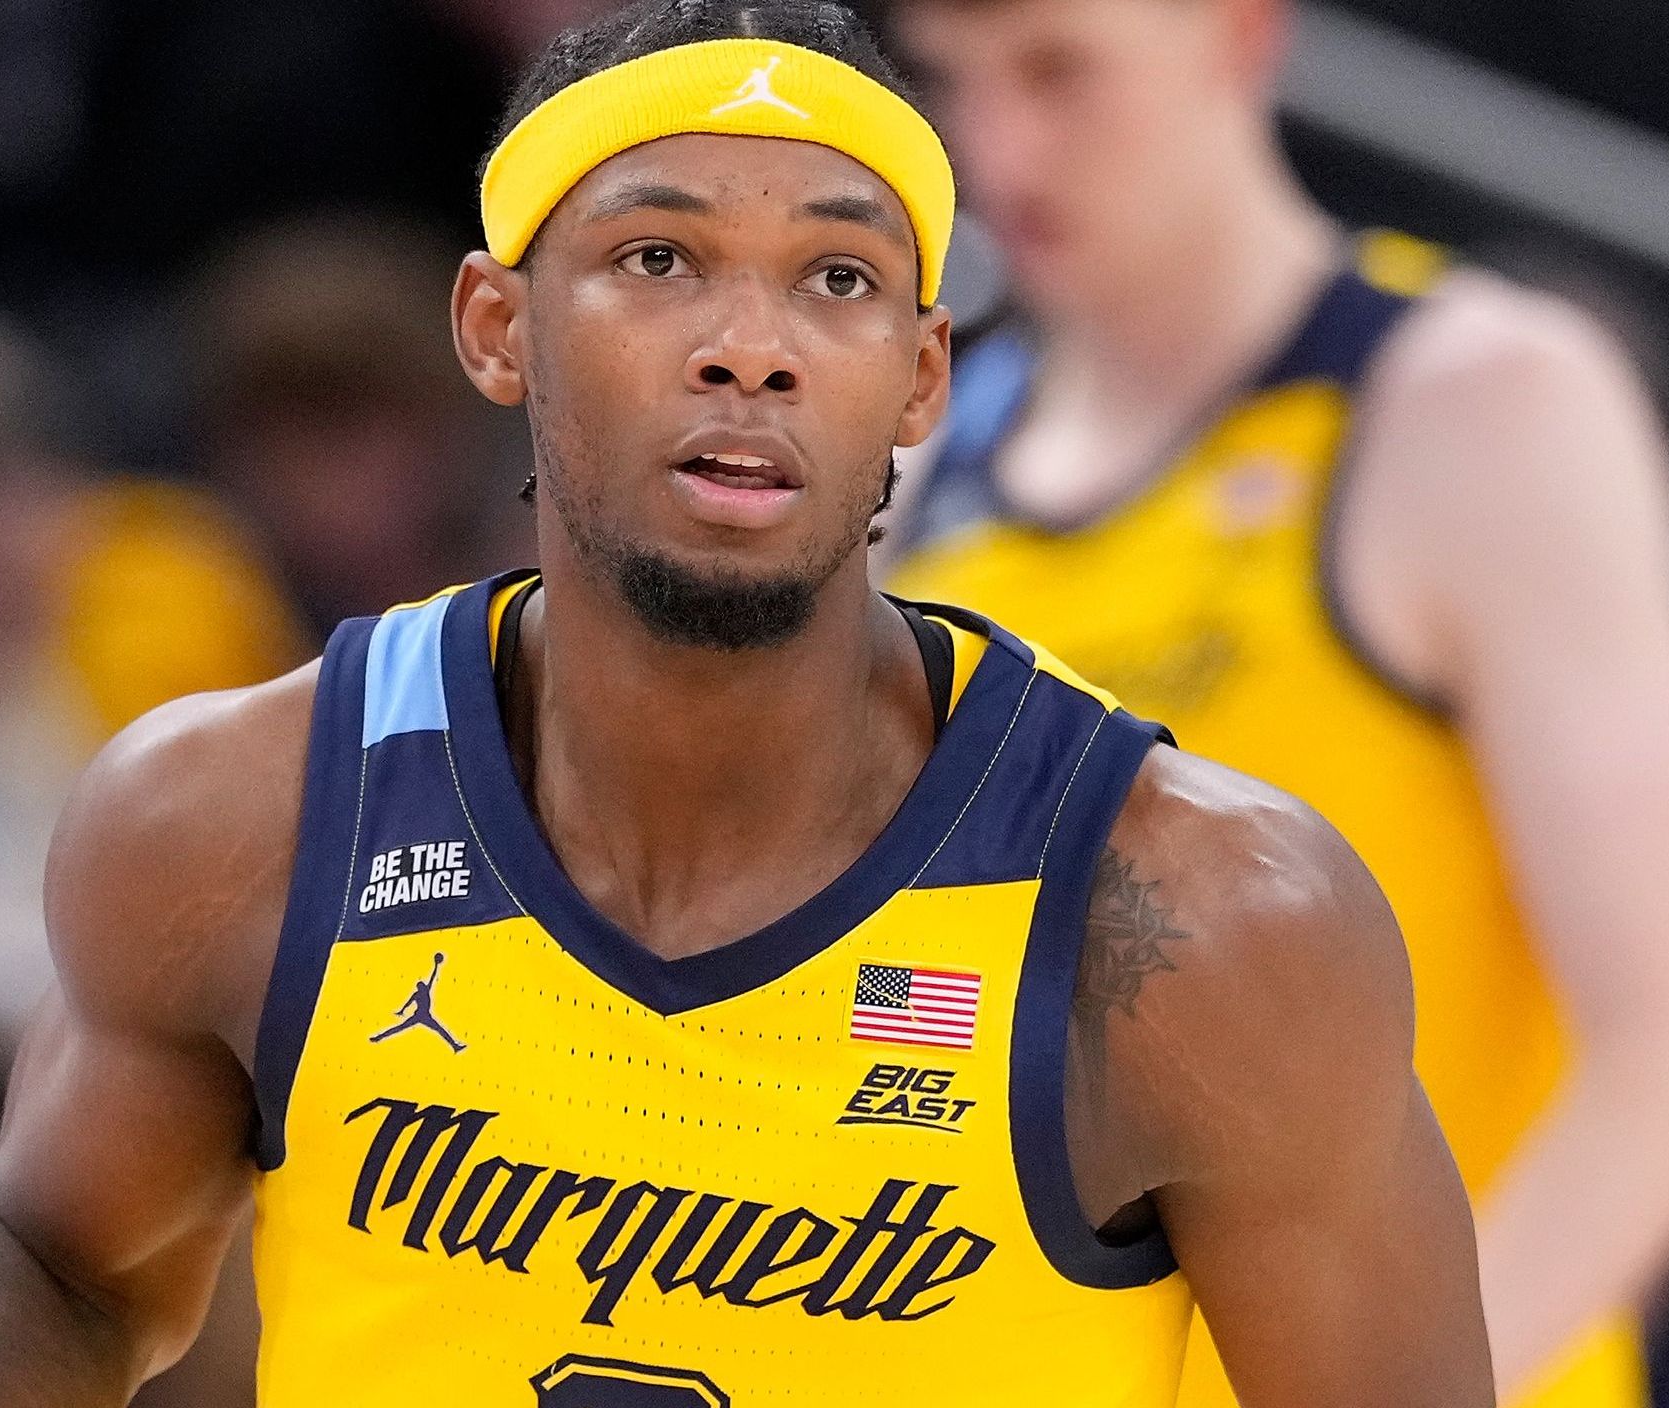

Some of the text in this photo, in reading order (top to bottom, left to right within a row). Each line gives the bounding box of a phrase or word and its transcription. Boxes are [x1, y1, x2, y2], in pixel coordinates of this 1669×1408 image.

[369, 841, 465, 884] BE THE
[359, 869, 471, 913] CHANGE
[861, 1063, 957, 1094] BIG
[844, 1089, 977, 1122] EAST
[343, 1097, 997, 1328] Marquette
